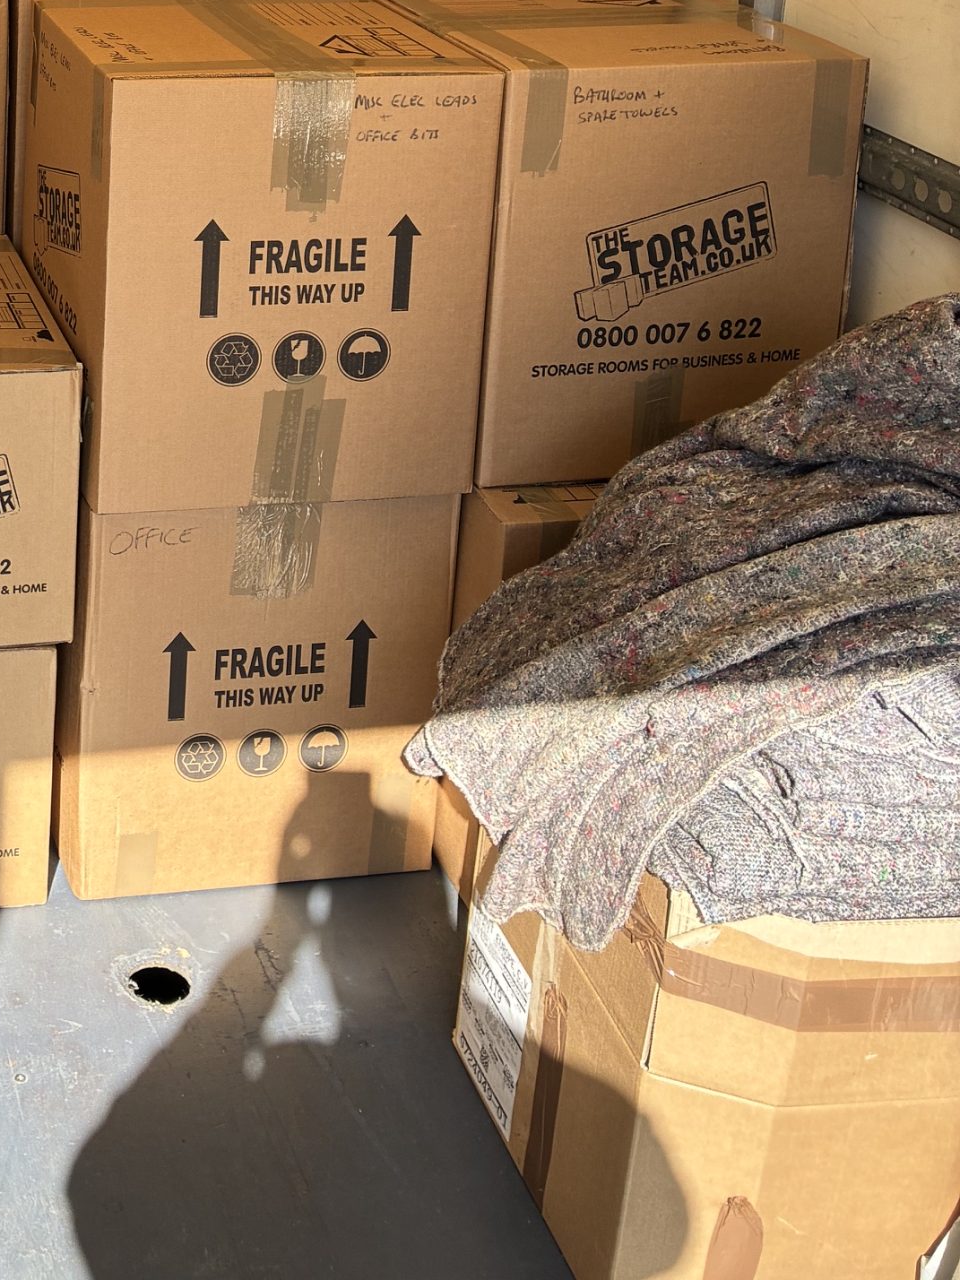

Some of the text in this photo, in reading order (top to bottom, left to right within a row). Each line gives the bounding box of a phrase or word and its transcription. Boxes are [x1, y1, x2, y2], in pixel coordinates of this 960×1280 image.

[391, 94, 425, 108] ELEC
[356, 130, 401, 142] OFFICE
[39, 186, 80, 229] STORAGE
[249, 237, 367, 275] FRAGILE
[592, 228, 630, 254] THE
[597, 202, 770, 285] STORAGE
[639, 234, 772, 293] TEAM.CO.UK
[249, 282, 365, 306] THIS WAY UP
[577, 318, 762, 348] 0800 007 6 822
[531, 349, 800, 378] STORAGE ROOMS FOR BUSINESS & HOME
[109, 526, 199, 556] OFFICE
[214, 642, 326, 681] FRAGILE
[215, 684, 324, 709] THIS WAY UP
